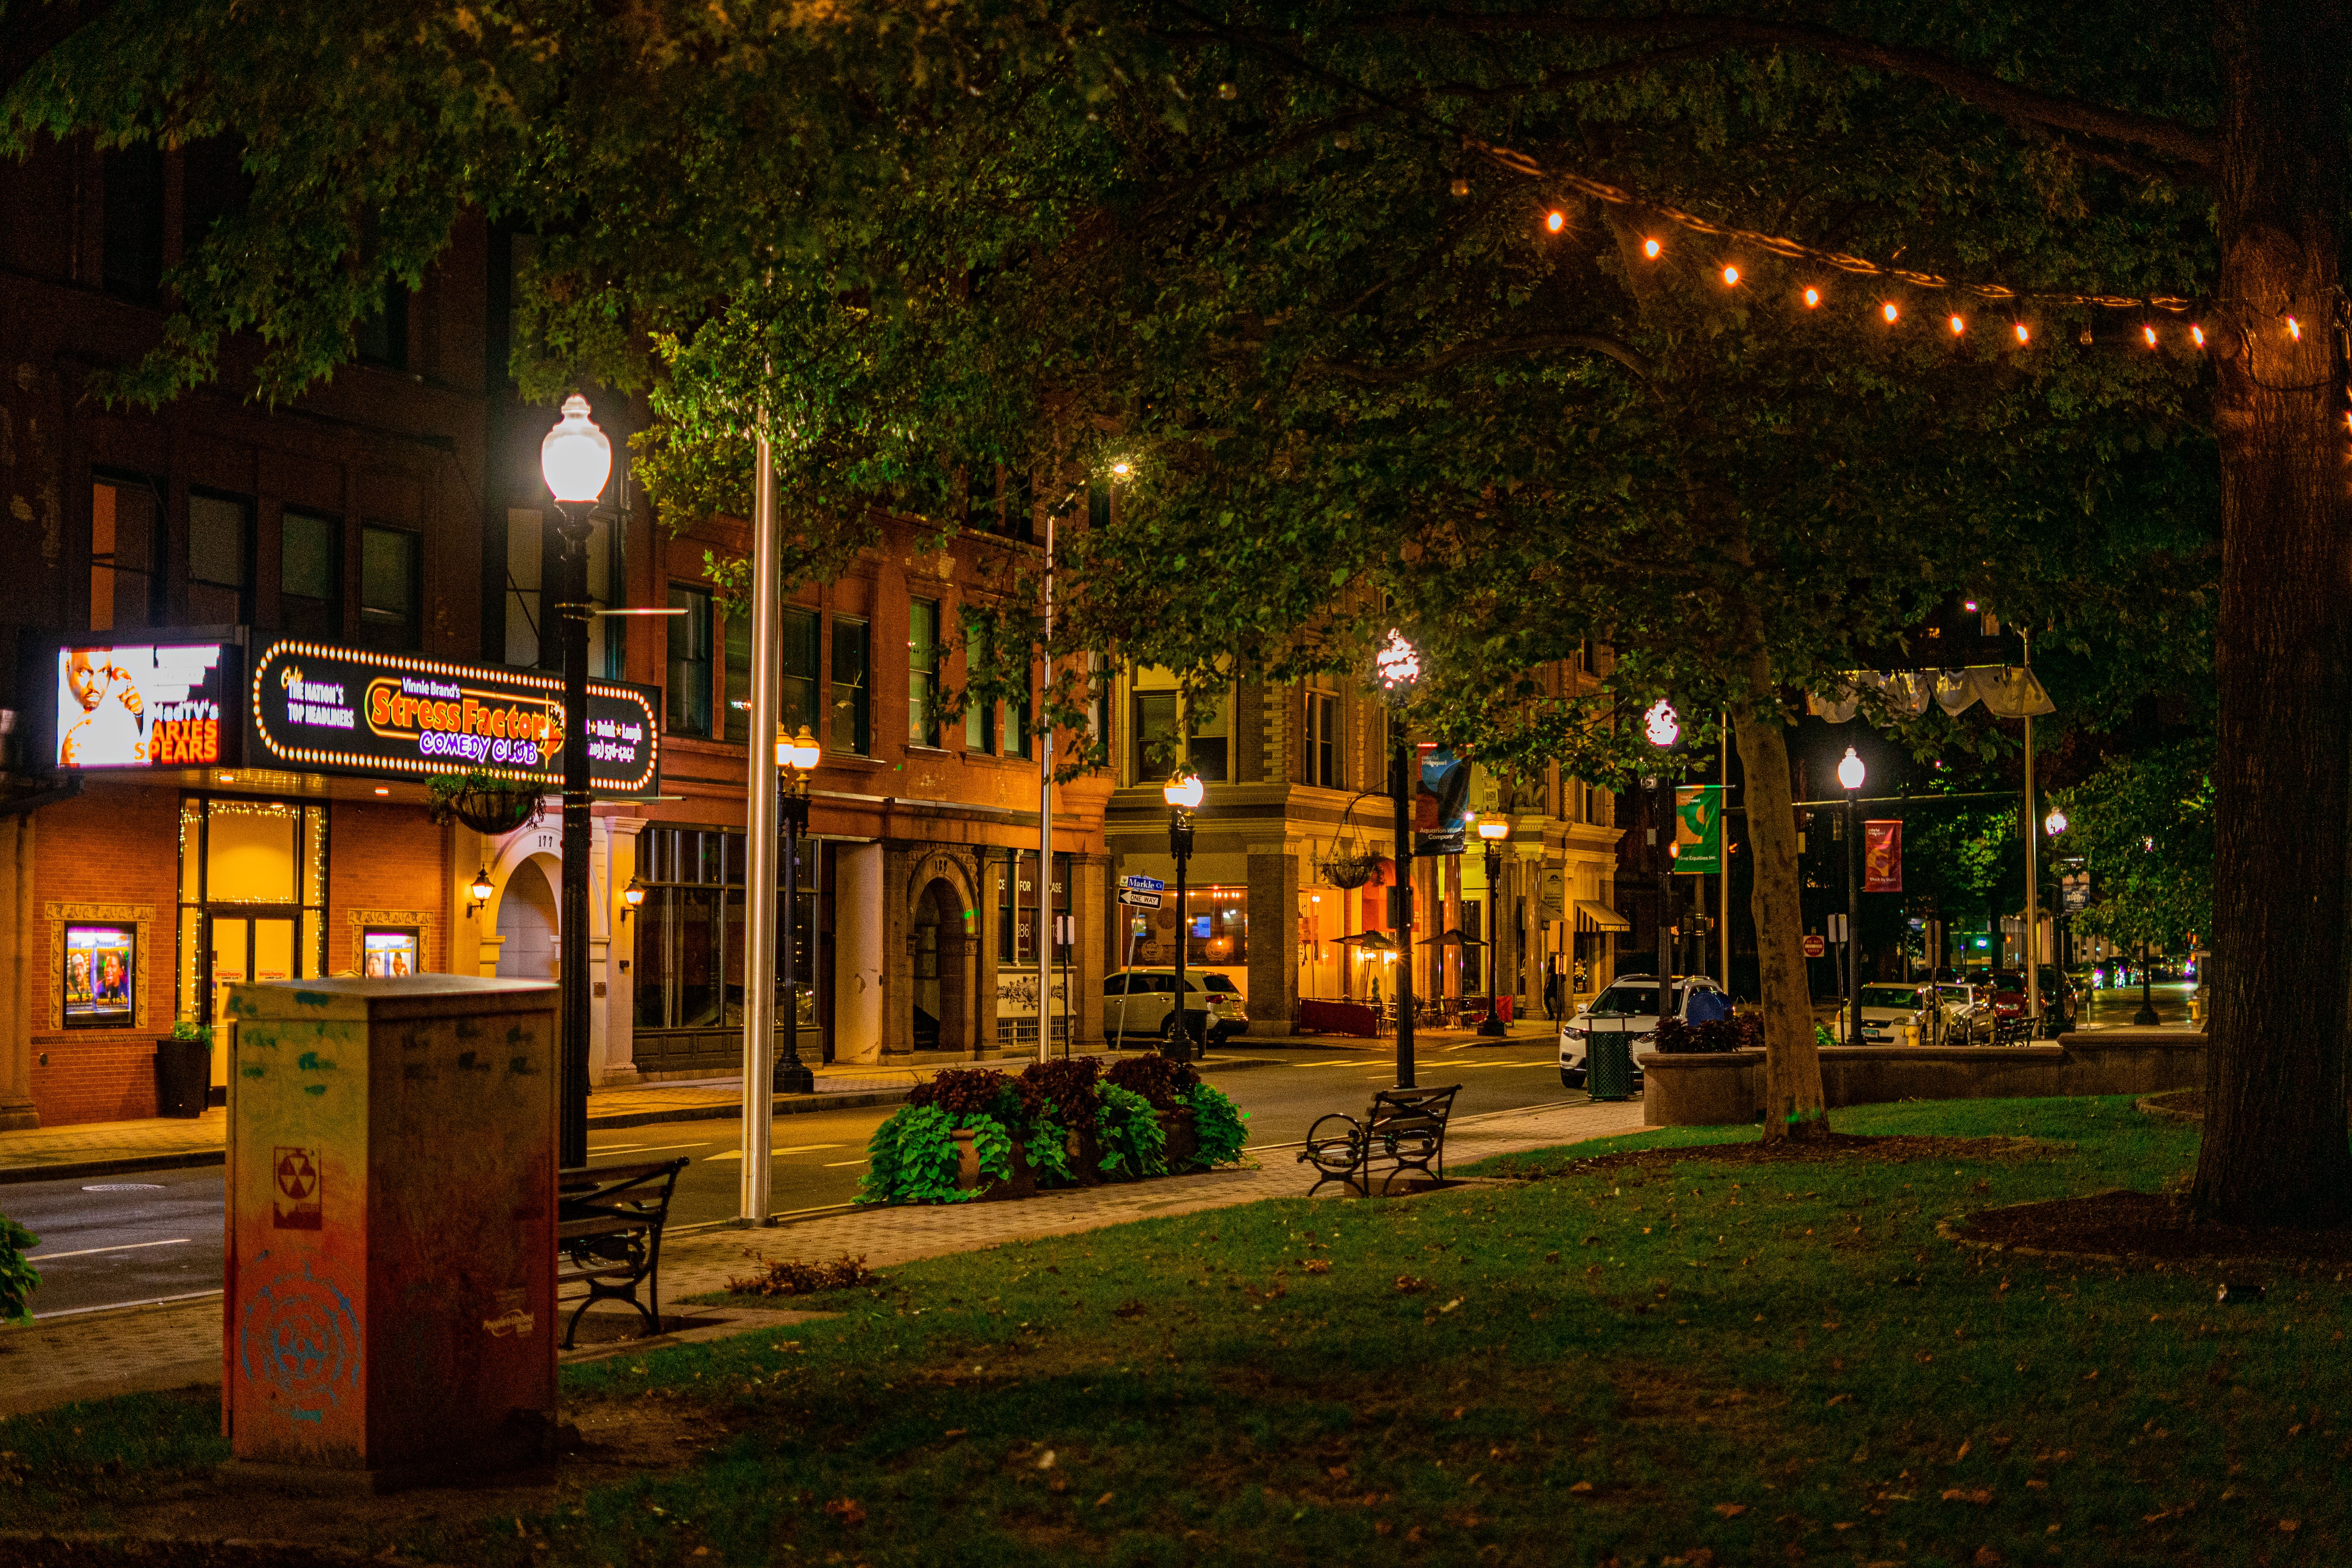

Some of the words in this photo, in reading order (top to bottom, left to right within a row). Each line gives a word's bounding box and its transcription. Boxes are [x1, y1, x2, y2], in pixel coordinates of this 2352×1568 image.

[288, 682, 304, 700] THE
[305, 683, 344, 705] NATION'S
[402, 678, 430, 695] Vinnie
[430, 682, 460, 698] Brand's
[153, 700, 219, 722] MadTV's
[288, 703, 305, 721] TOP
[305, 705, 354, 727] HEADLINERS
[371, 688, 462, 732] Stress
[152, 720, 217, 741] ARIES
[597, 720, 616, 738] Drink
[622, 723, 642, 745] Laugh
[134, 739, 217, 762] SPEARS
[420, 730, 491, 763] COMEDY
[492, 738, 538, 765] CLUB
[588, 739, 604, 759] 203)
[538, 835, 553, 848] 177
[1019, 880, 1031, 892] FOR
[1051, 882, 1062, 893] ASE
[1129, 878, 1154, 889] Markle
